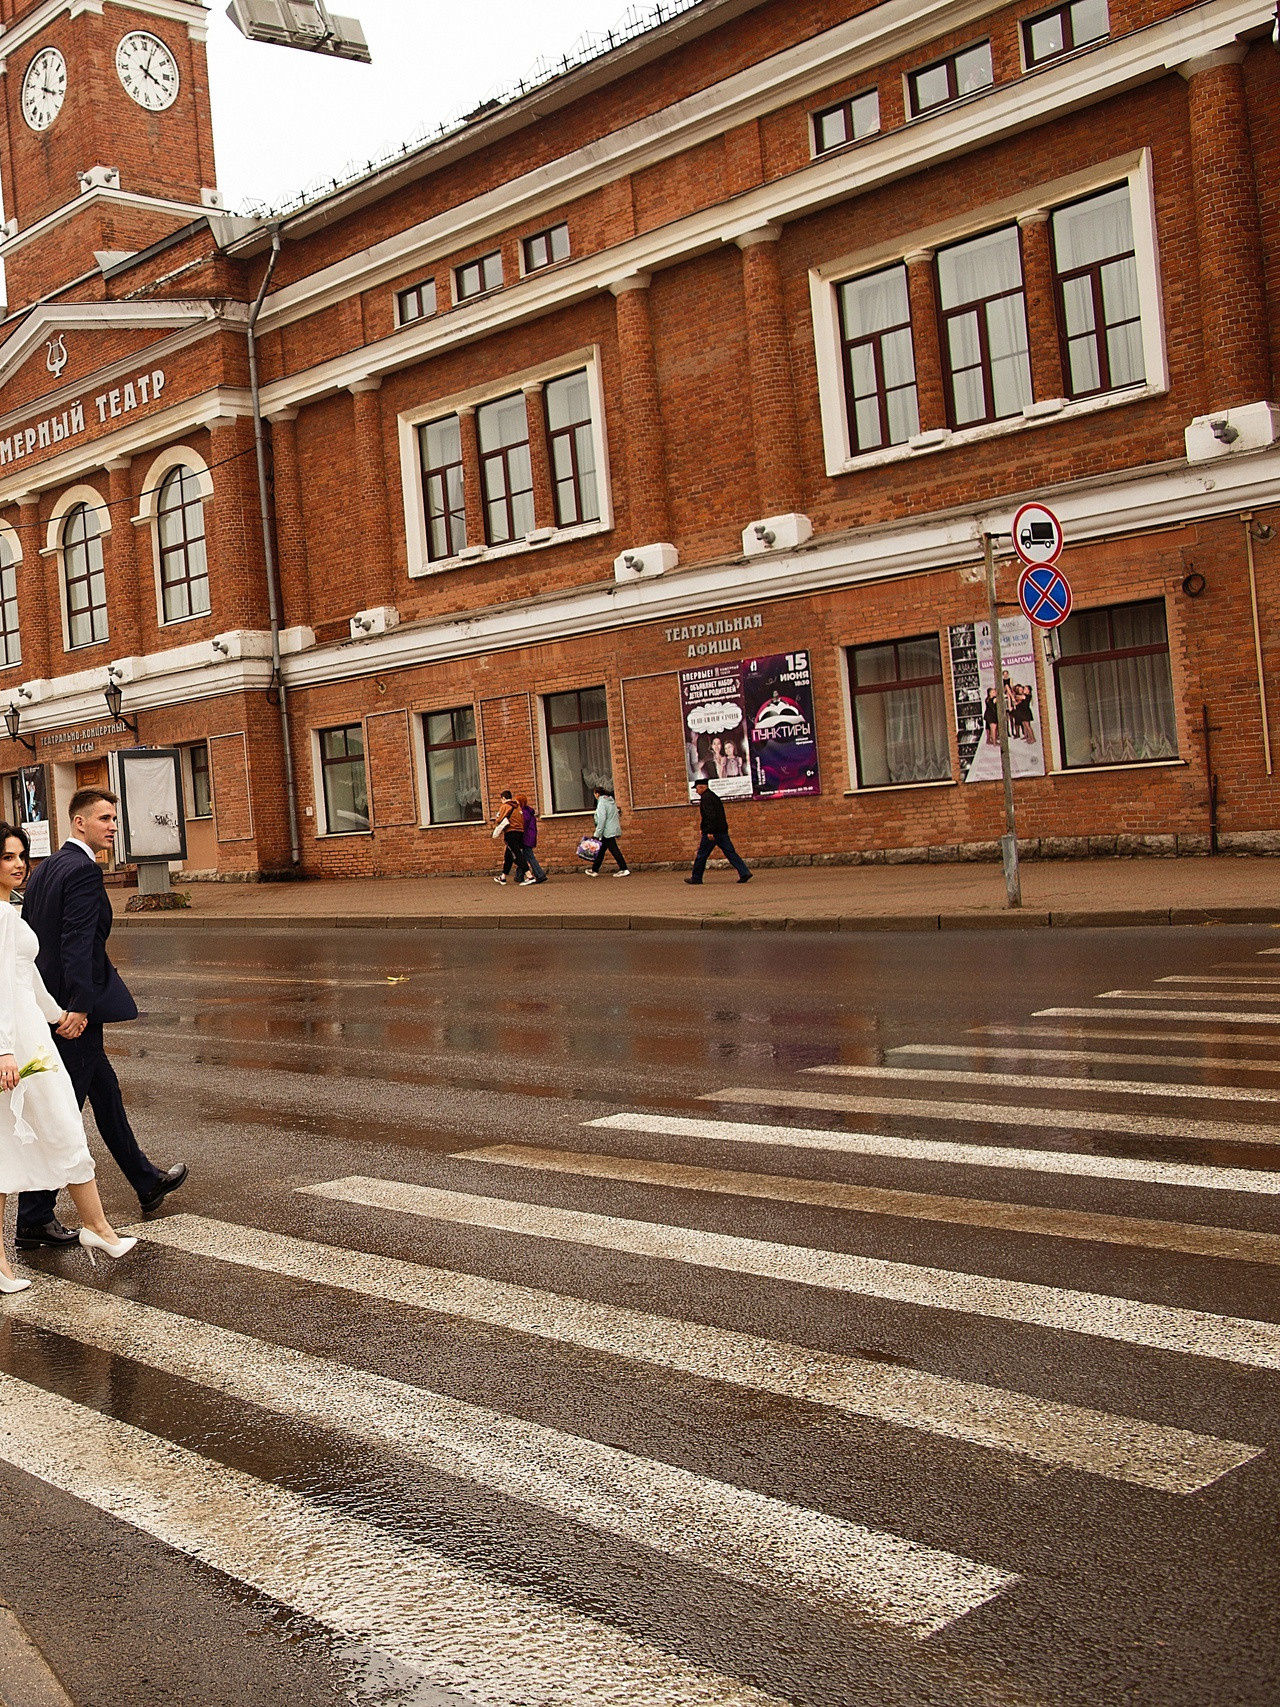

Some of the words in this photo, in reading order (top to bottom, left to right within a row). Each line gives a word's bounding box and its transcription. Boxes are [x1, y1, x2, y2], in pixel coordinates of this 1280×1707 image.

[95, 369, 167, 423] ТЕАТР
[665, 613, 763, 643] ТЕАТРАЛЬНАЯ
[687, 637, 742, 658] АФИША
[785, 652, 808, 672] 15
[981, 660, 994, 668] ША
[1006, 655, 1032, 665] ШАГОМ
[780, 670, 810, 682] ИЮНЯ
[40, 721, 127, 746] ТЕАТРАЛЬНО-КОНЦЕРТНЫЕ
[752, 722, 811, 741] ПУНКТИРЫ
[72, 742, 94, 754] КАССЫ
